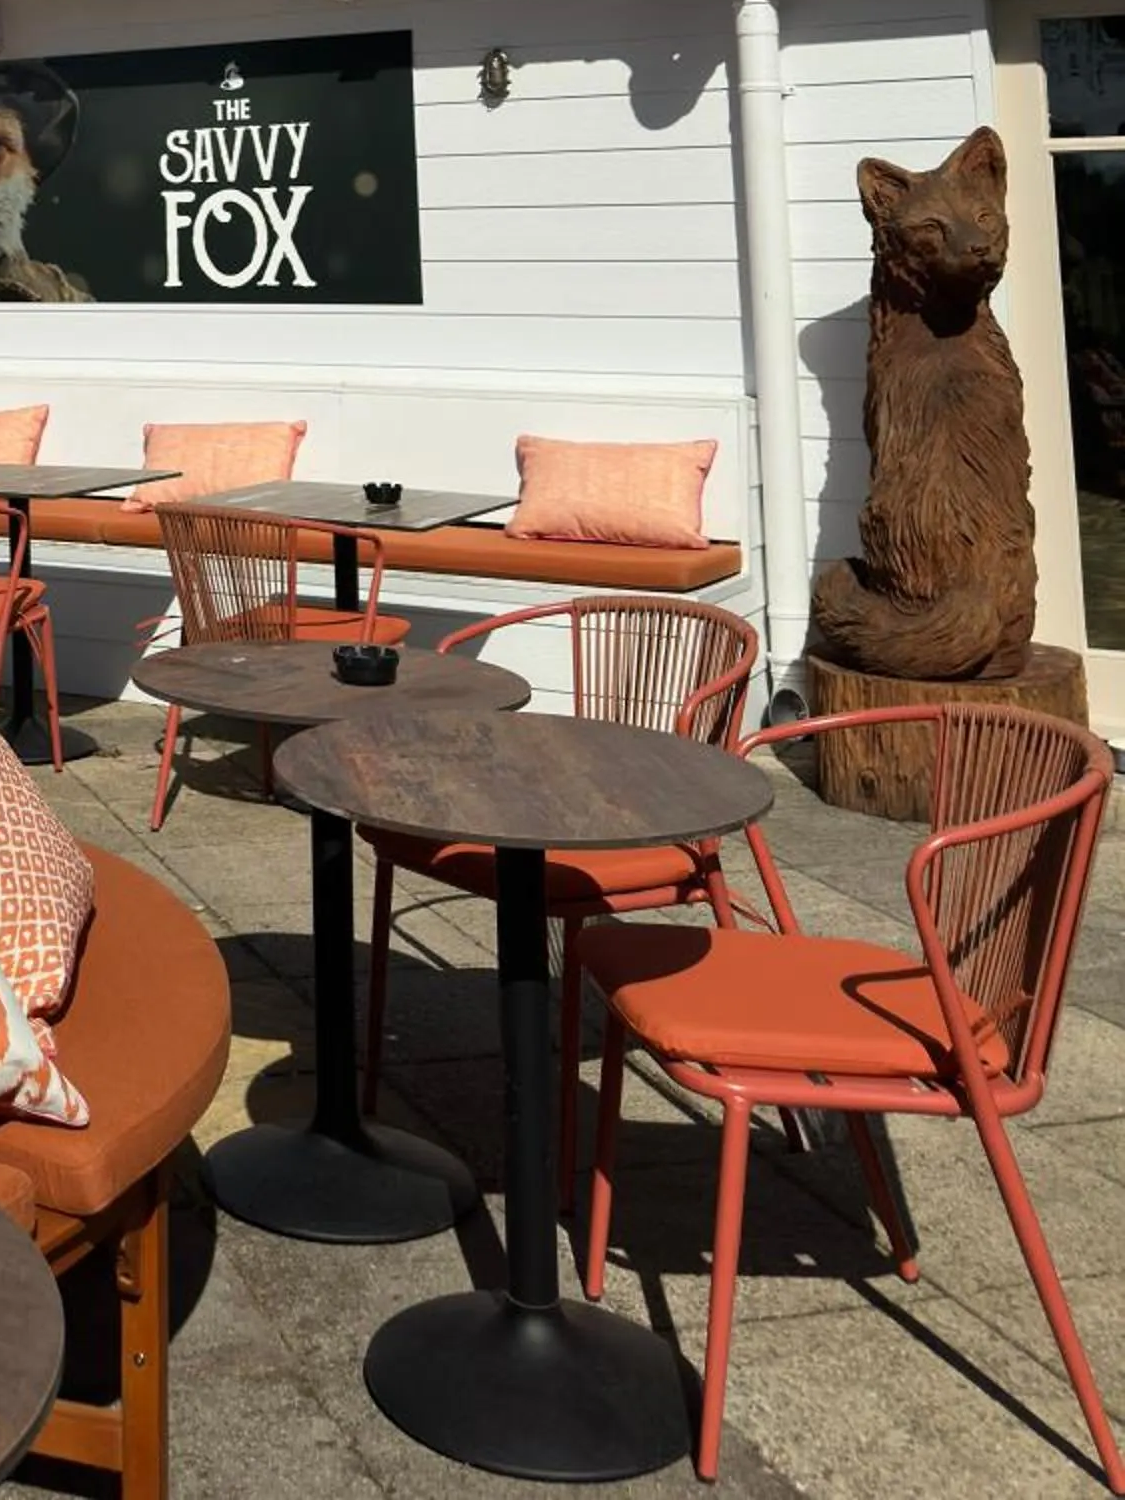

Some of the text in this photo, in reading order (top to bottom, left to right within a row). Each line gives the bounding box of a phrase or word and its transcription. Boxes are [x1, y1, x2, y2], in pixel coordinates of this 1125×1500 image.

[213, 98, 252, 121] THE
[159, 122, 311, 184] SAVVY
[160, 186, 317, 289] FOX
